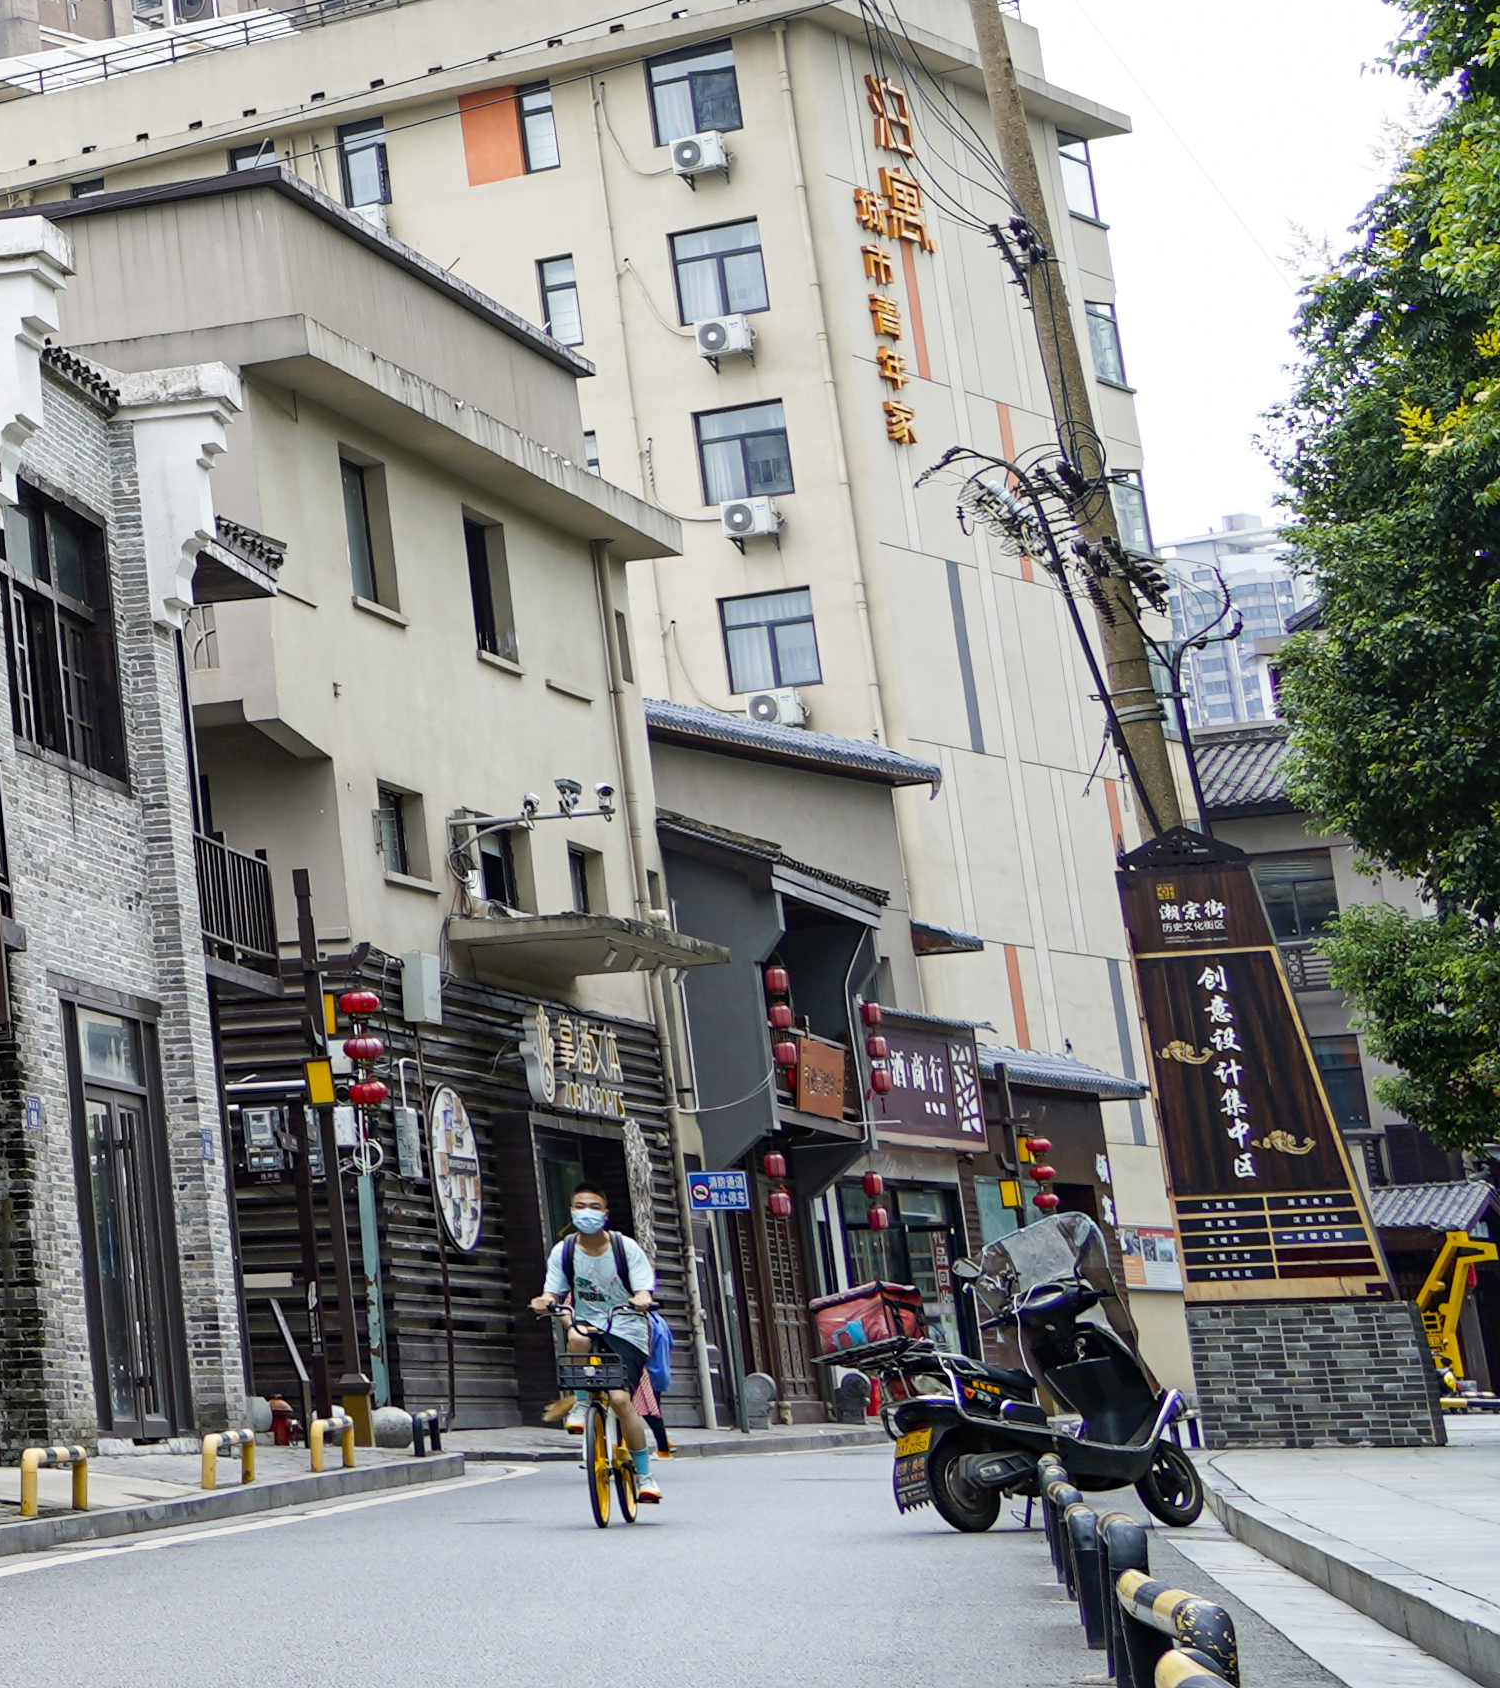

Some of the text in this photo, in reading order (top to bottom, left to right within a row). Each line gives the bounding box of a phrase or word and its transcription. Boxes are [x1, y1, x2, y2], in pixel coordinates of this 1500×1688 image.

[853, 187, 918, 445] 城市青年家
[1159, 898, 1227, 921] 潮宗街
[1162, 919, 1226, 933] 历史文化街区
[1197, 965, 1257, 1179] 创意设计集中区
[708, 1175, 744, 1190] 消防通道
[710, 1191, 747, 1206] 禁止停车
